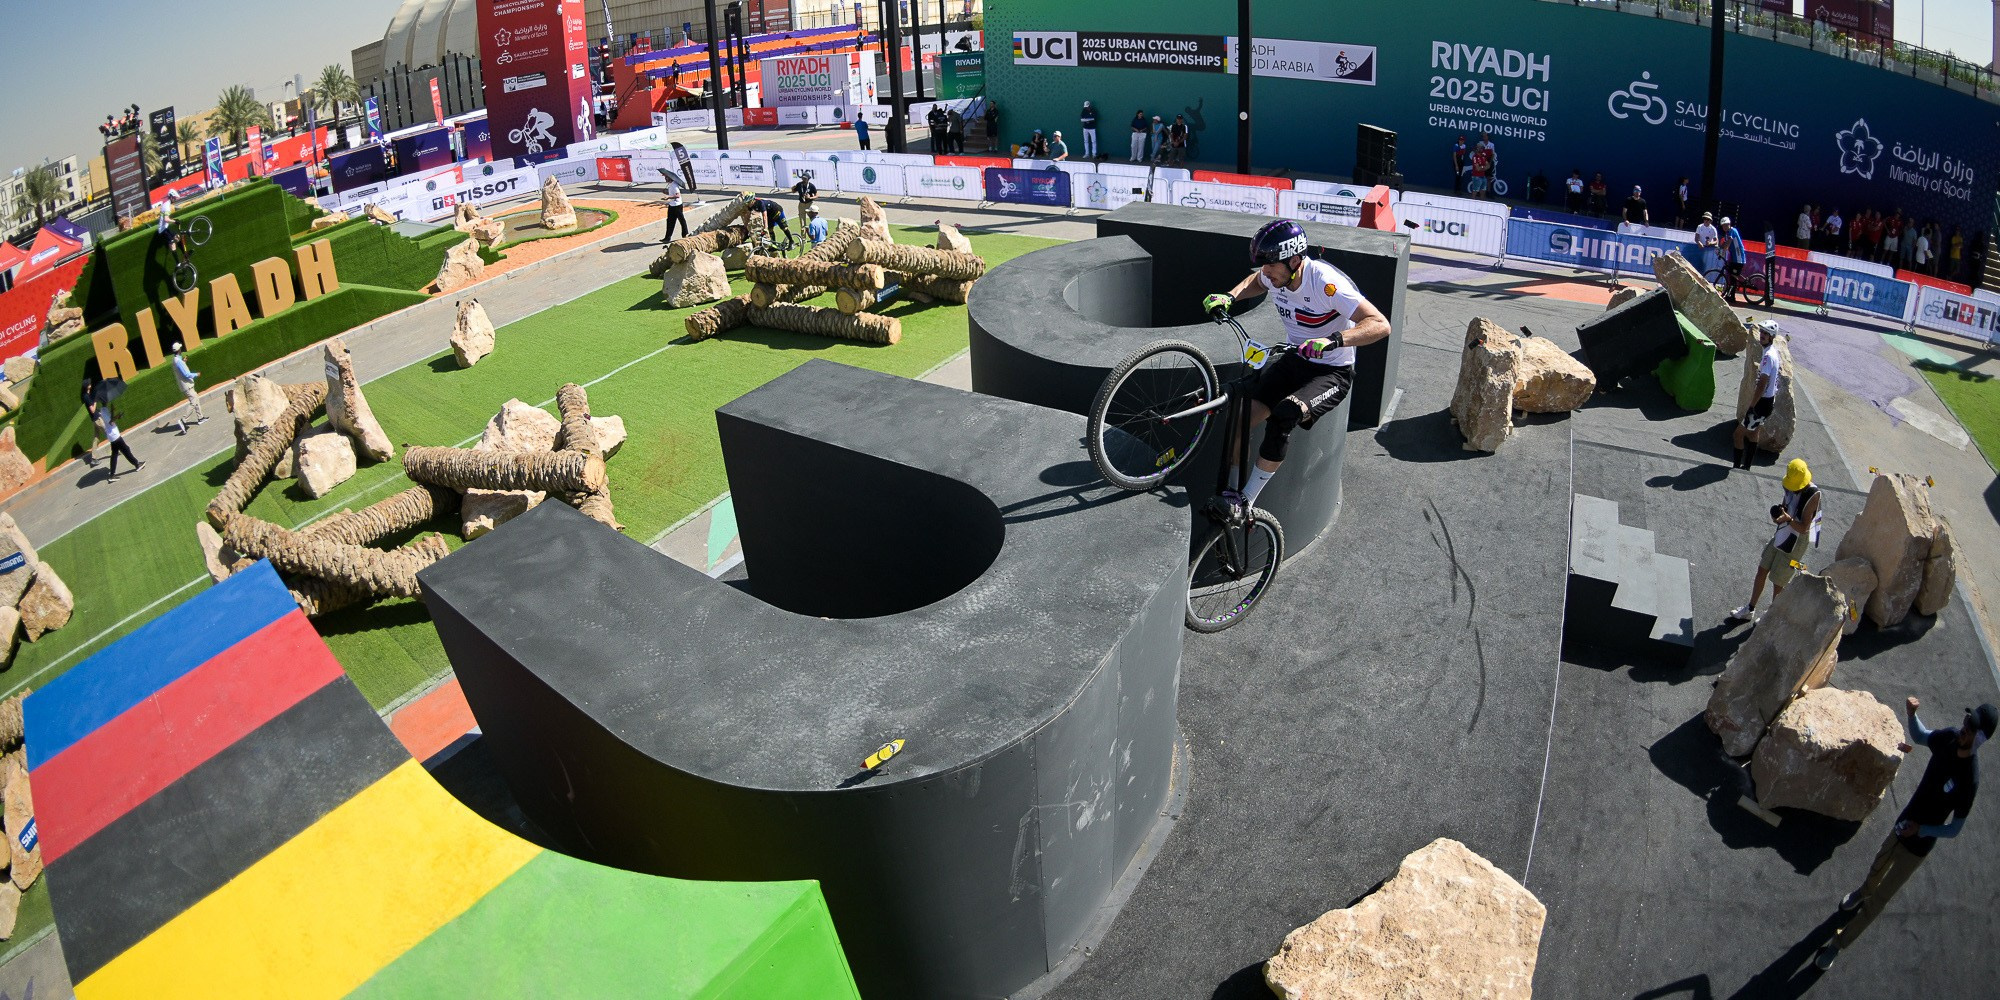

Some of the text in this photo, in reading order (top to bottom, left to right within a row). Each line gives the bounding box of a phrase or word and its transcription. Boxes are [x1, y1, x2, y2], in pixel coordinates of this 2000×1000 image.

[494, 2, 545, 17] CHAMPIONSHIPS
[514, 33, 530, 42] Ministry
[536, 30, 548, 39] Sport
[514, 50, 529, 58] SAUDI
[529, 47, 549, 56] CYCLING
[1023, 37, 1073, 60] UCI
[1082, 38, 1198, 52] 2025 URBAN CYCLING
[1234, 43, 1276, 57] RADH
[777, 57, 830, 76] RIYADH
[955, 58, 981, 67] RIYADH
[1083, 51, 1221, 67] WORLD CHAMPIONSHIPS
[1234, 57, 1315, 74] SUDI ARABIA
[1431, 40, 1550, 82] RIYADH
[505, 77, 517, 85] UCI
[778, 73, 831, 89] 2025 UCI
[1430, 75, 1549, 112] 2025 UCI
[875, 110, 888, 119] UCI
[1429, 103, 1548, 127] URBAN CYCLING WORLD
[1675, 100, 1800, 138] SAUI CYCLING
[1428, 116, 1546, 142] CHAMPIONSHIPS
[678, 149, 685, 158] 5
[1892, 142, 1974, 185] وزارة الرياضة
[457, 177, 519, 205] TISSOT
[1889, 164, 1972, 202] Ministry of Sport
[1209, 198, 1268, 211] SAUDI CYCLING
[1302, 202, 1319, 212] UCI
[1431, 219, 1466, 237] UCI
[1279, 232, 1307, 250] TRIAL
[1767, 234, 1773, 249] 3
[1279, 242, 1307, 260] BIKES
[91, 238, 340, 382] RIYADH
[6, 314, 37, 336] CYCLING
